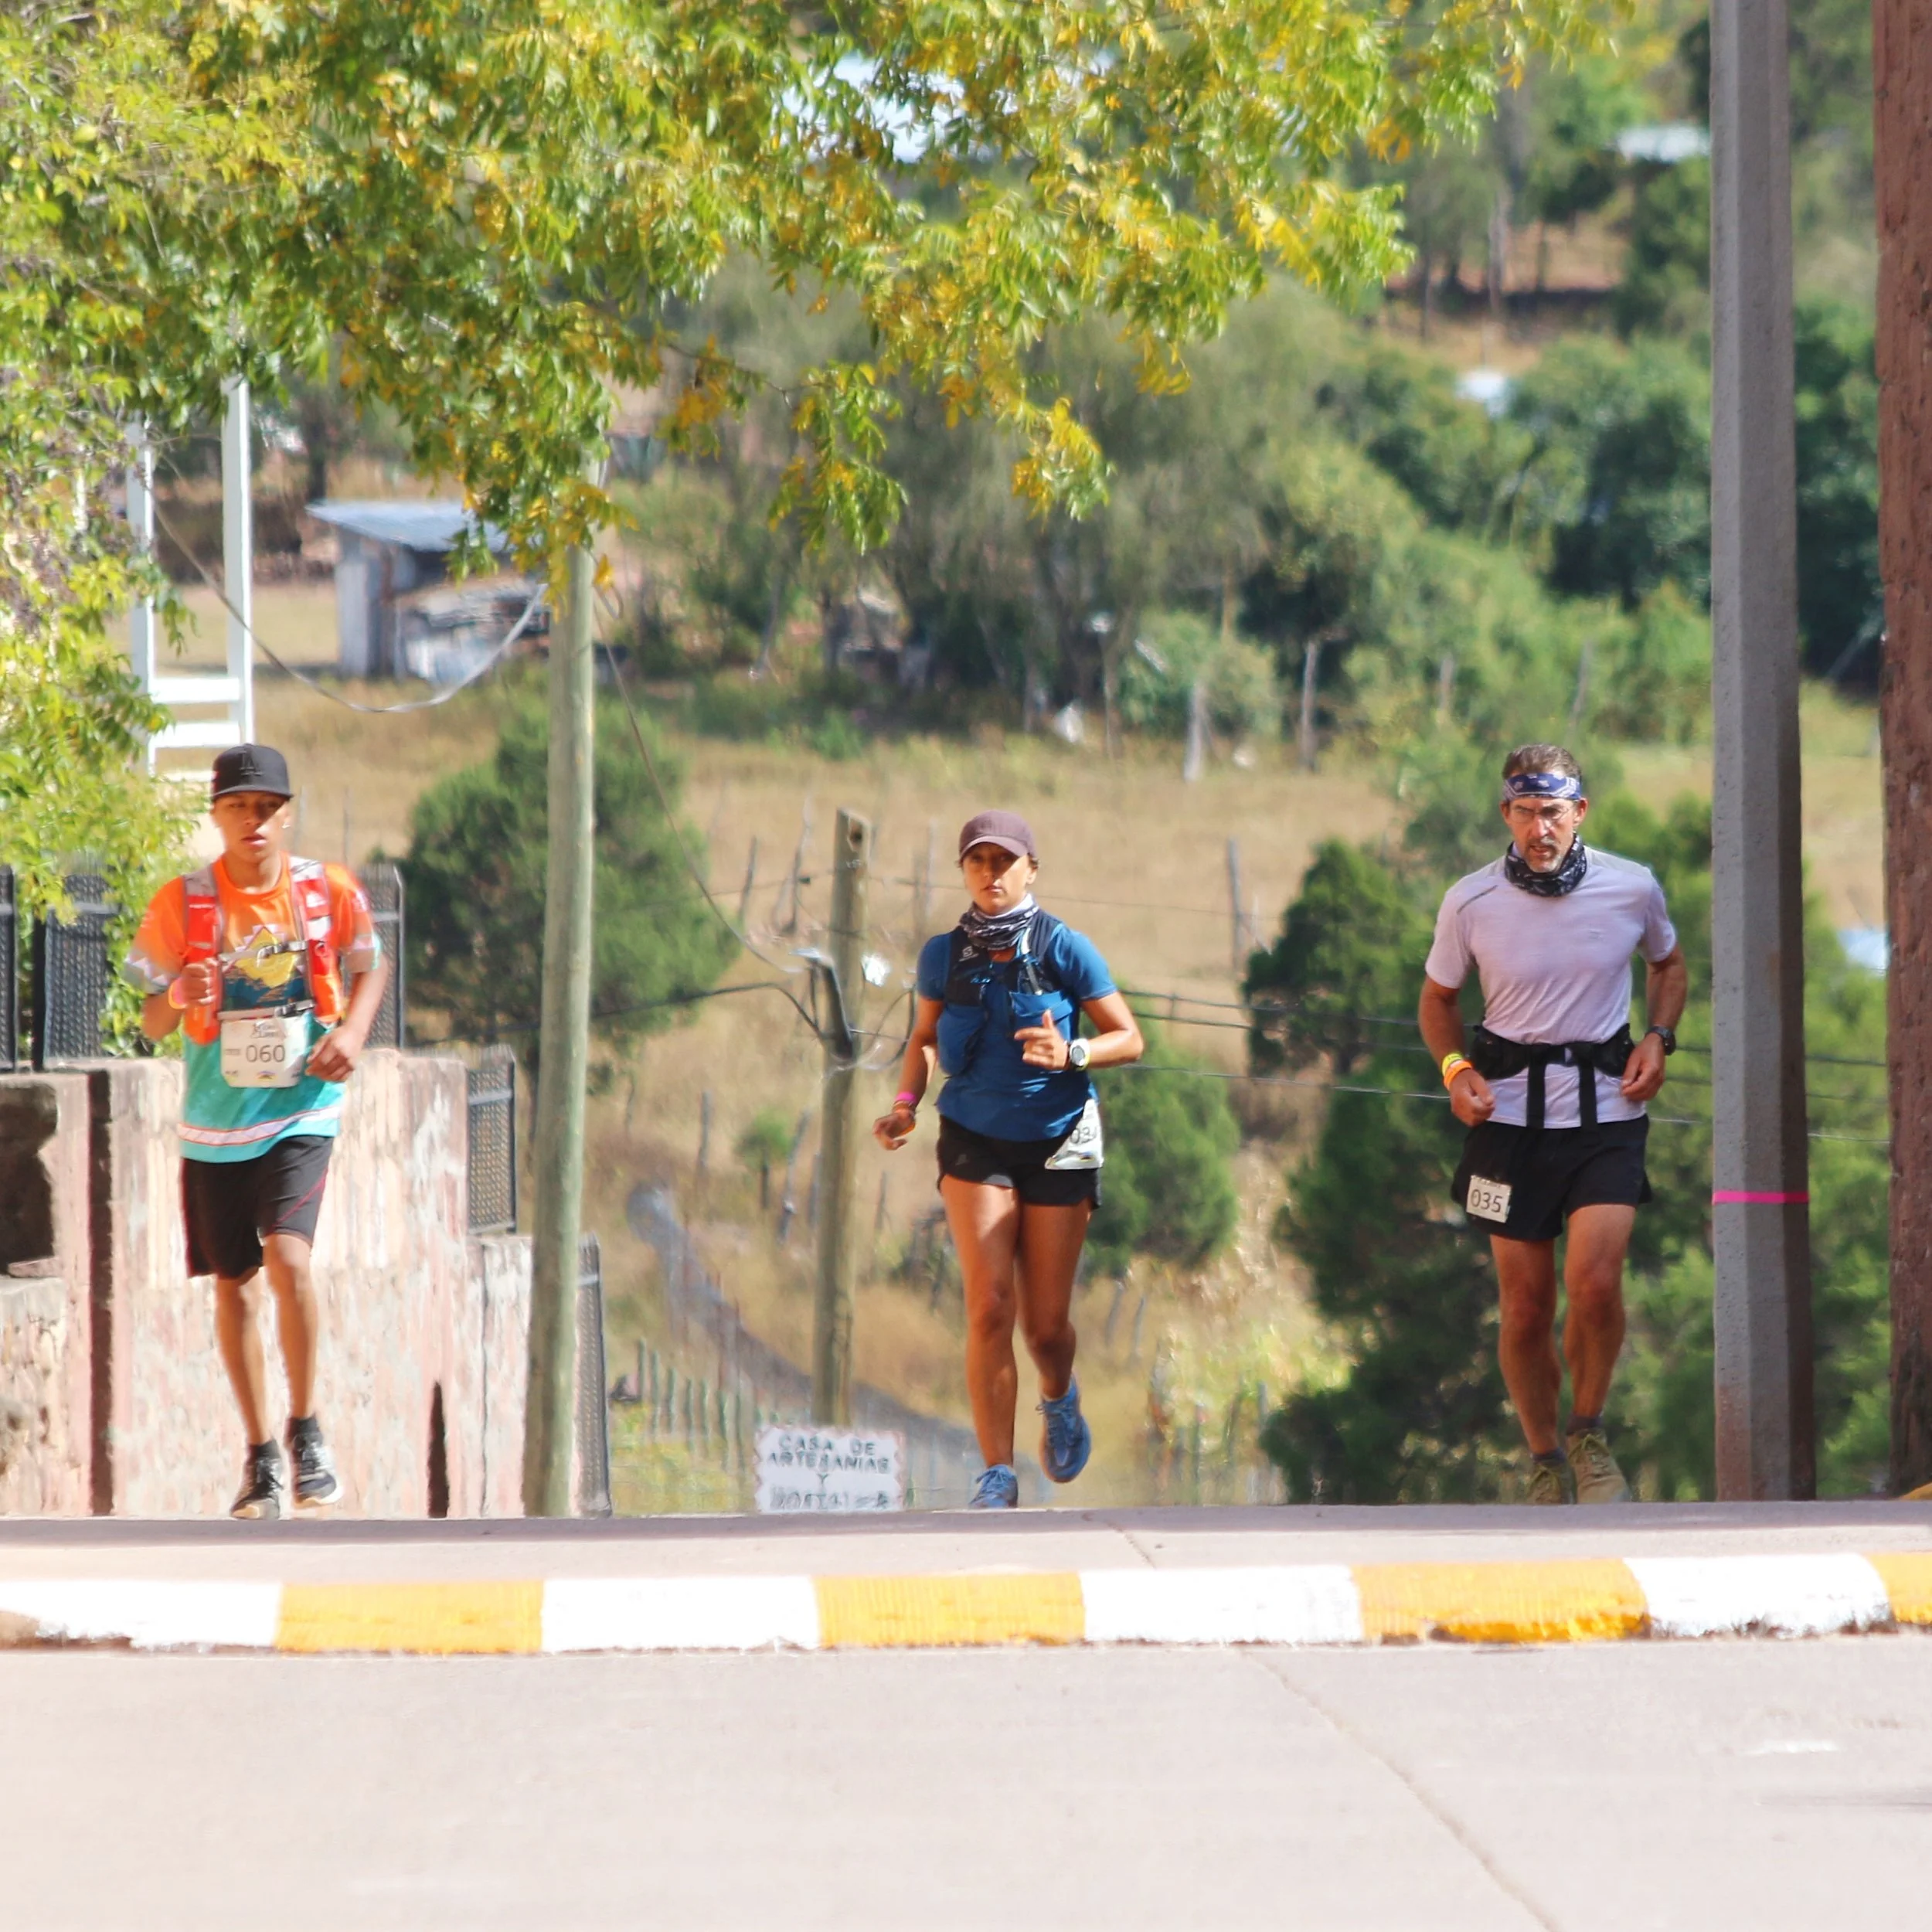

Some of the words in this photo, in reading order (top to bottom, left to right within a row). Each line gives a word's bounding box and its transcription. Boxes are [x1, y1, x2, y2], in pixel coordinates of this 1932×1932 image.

[245, 1044, 286, 1063] 060
[1470, 1189, 1503, 1213] 035
[778, 1434, 835, 1451] CASA
[849, 1437, 876, 1457] DE
